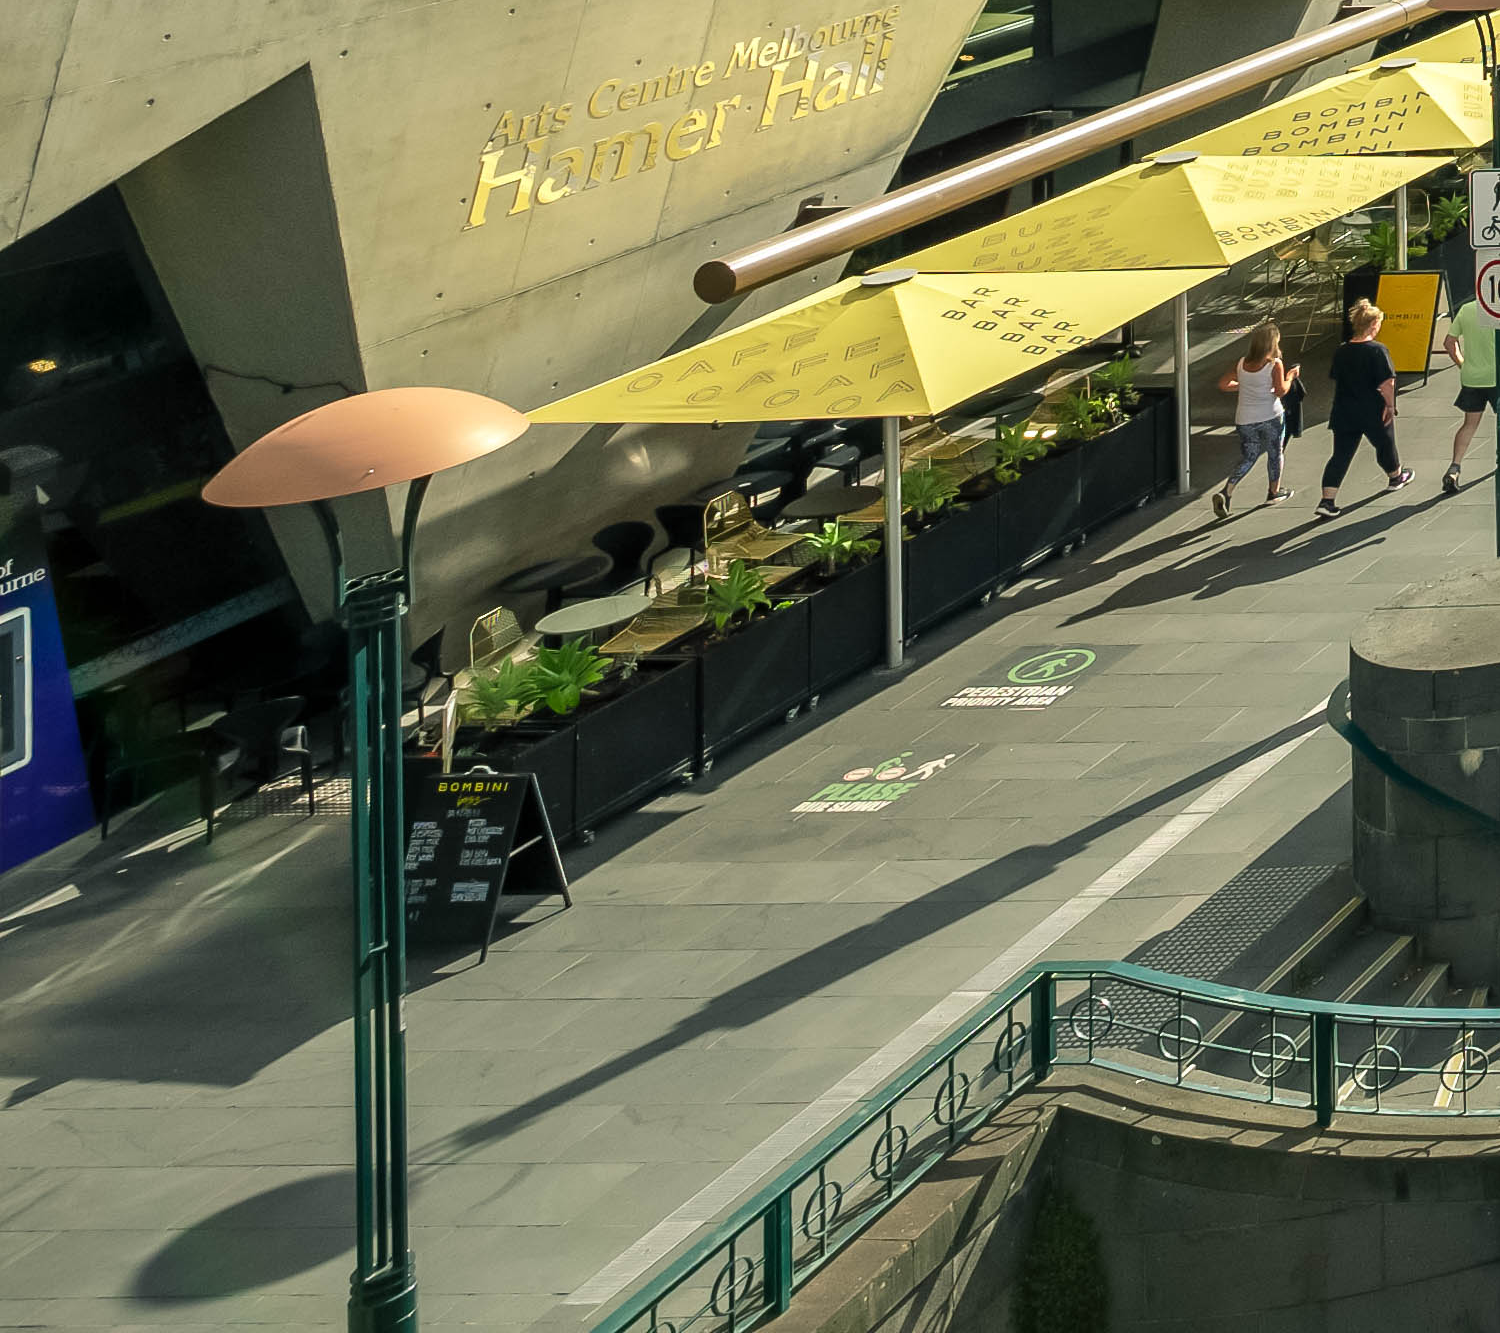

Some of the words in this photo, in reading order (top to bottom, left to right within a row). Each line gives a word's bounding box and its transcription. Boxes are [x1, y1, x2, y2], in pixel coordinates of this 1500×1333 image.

[483, 101, 574, 152] Arts
[587, 59, 714, 120] Centre
[724, 4, 900, 80] Melbourne
[462, 95, 743, 230] Hamer
[754, 30, 896, 134] Hall
[1242, 122, 1404, 156] BOMBINI
[1262, 105, 1421, 141] BOMBINI
[941, 287, 1000, 321] BAR
[972, 297, 1031, 331] BAR
[1000, 308, 1056, 343] BAR
[1021, 321, 1080, 355] BAR
[626, 327, 820, 394] CAFE
[686, 336, 881, 405] CAFE
[940, 696, 1013, 707] PRIORITY
[1011, 696, 1059, 707] AREA
[954, 686, 1075, 698] PEDESTRIAN
[437, 781, 510, 793] BOMBINI
[807, 782, 920, 802] PLEASE
